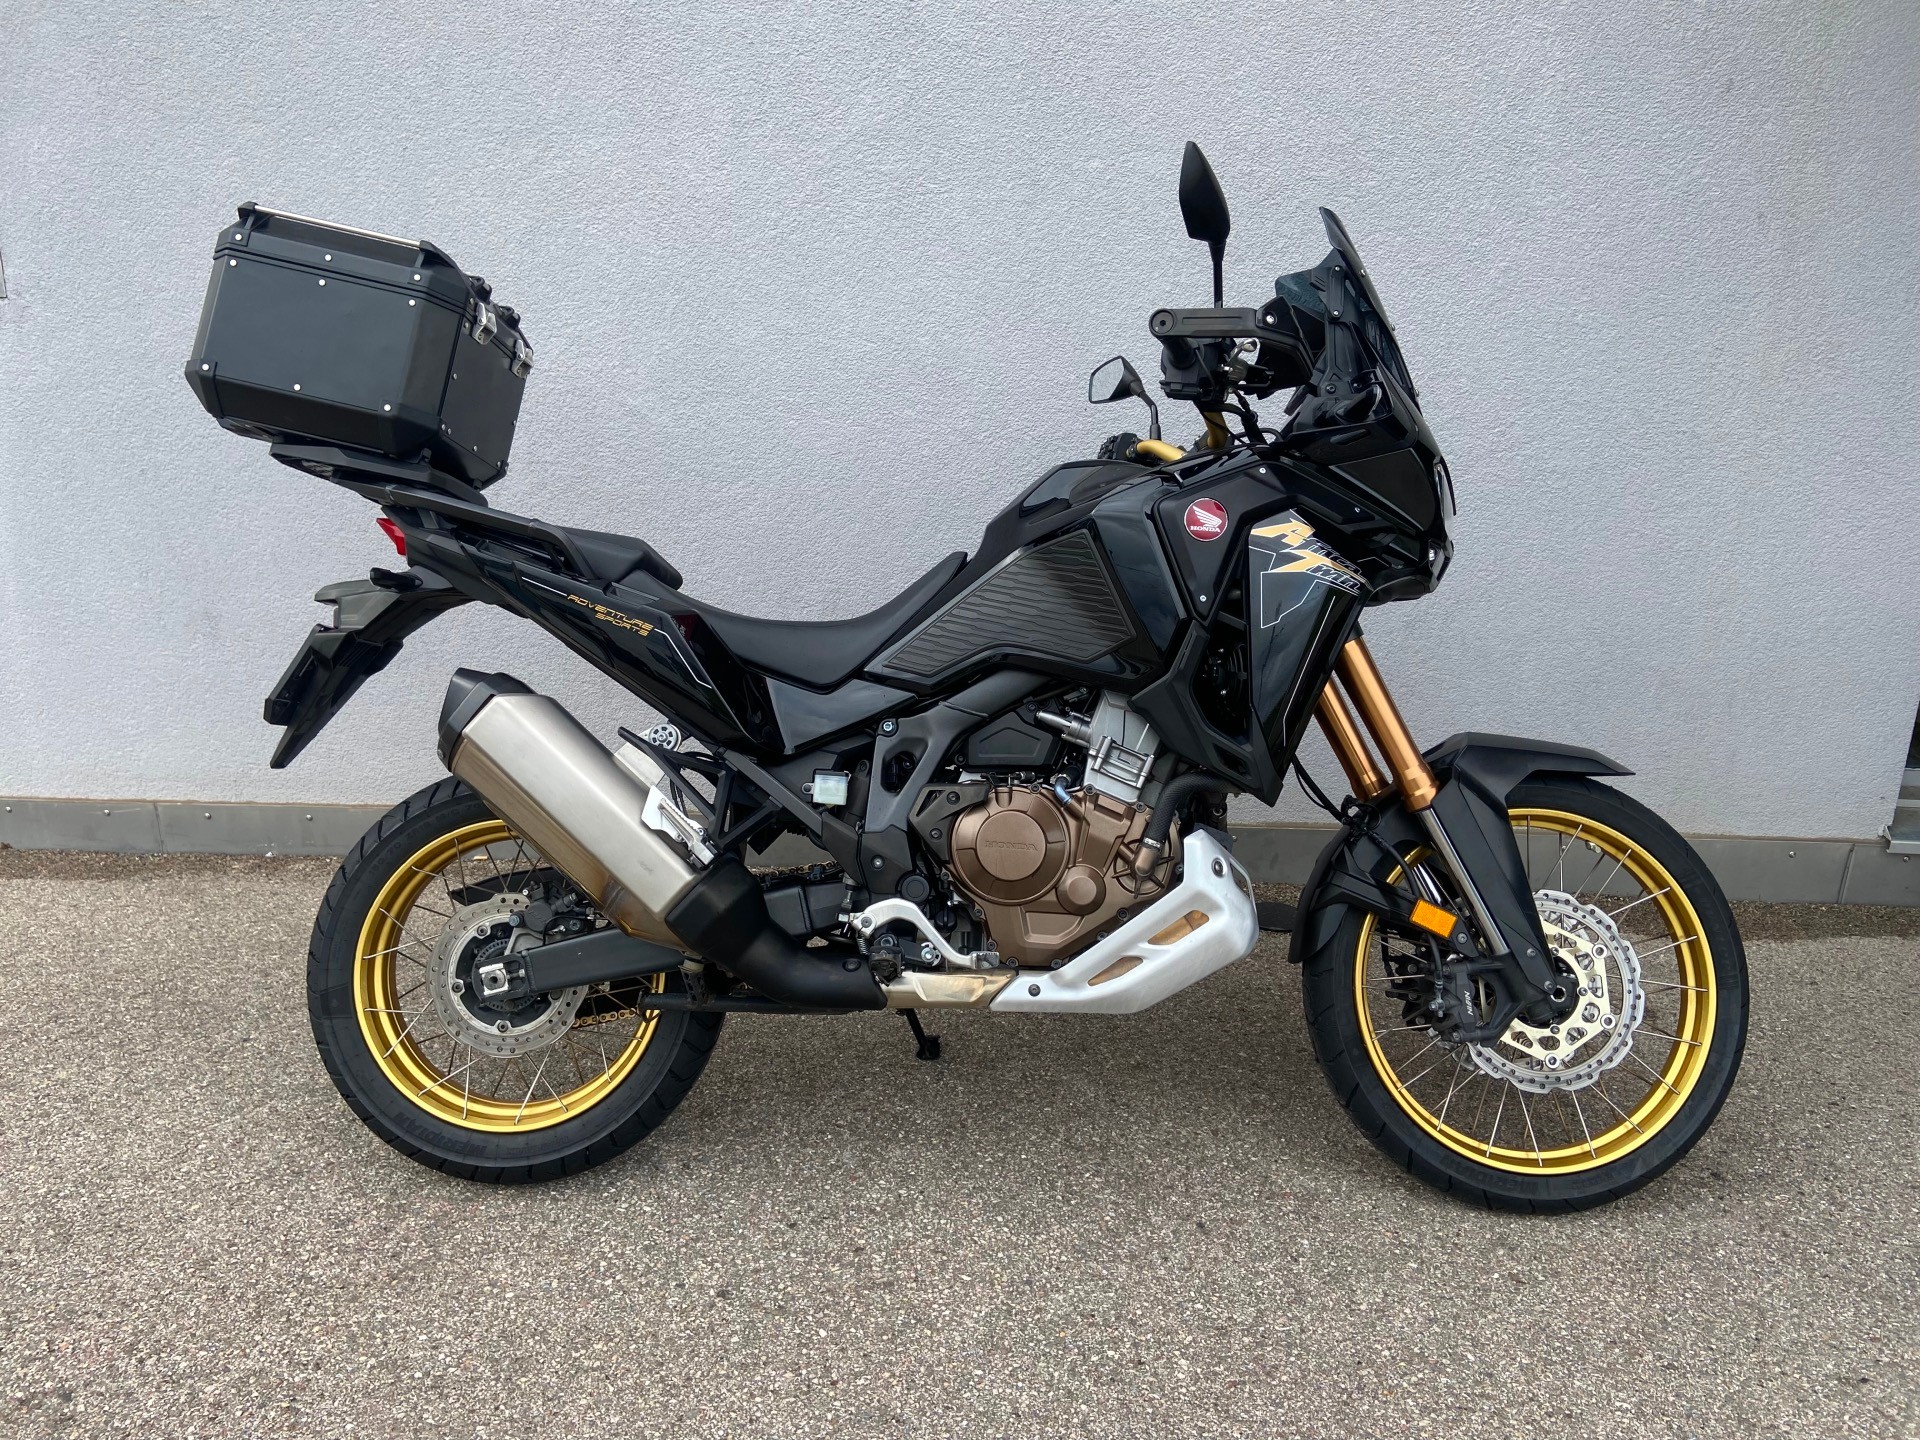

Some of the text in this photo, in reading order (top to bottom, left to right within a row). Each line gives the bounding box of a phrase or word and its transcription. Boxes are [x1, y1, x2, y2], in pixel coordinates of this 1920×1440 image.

[1190, 525, 1221, 533] HONDA
[567, 594, 654, 631] ADVENTURE
[595, 612, 649, 637] SPORTS
[985, 840, 1038, 851] HONDA
